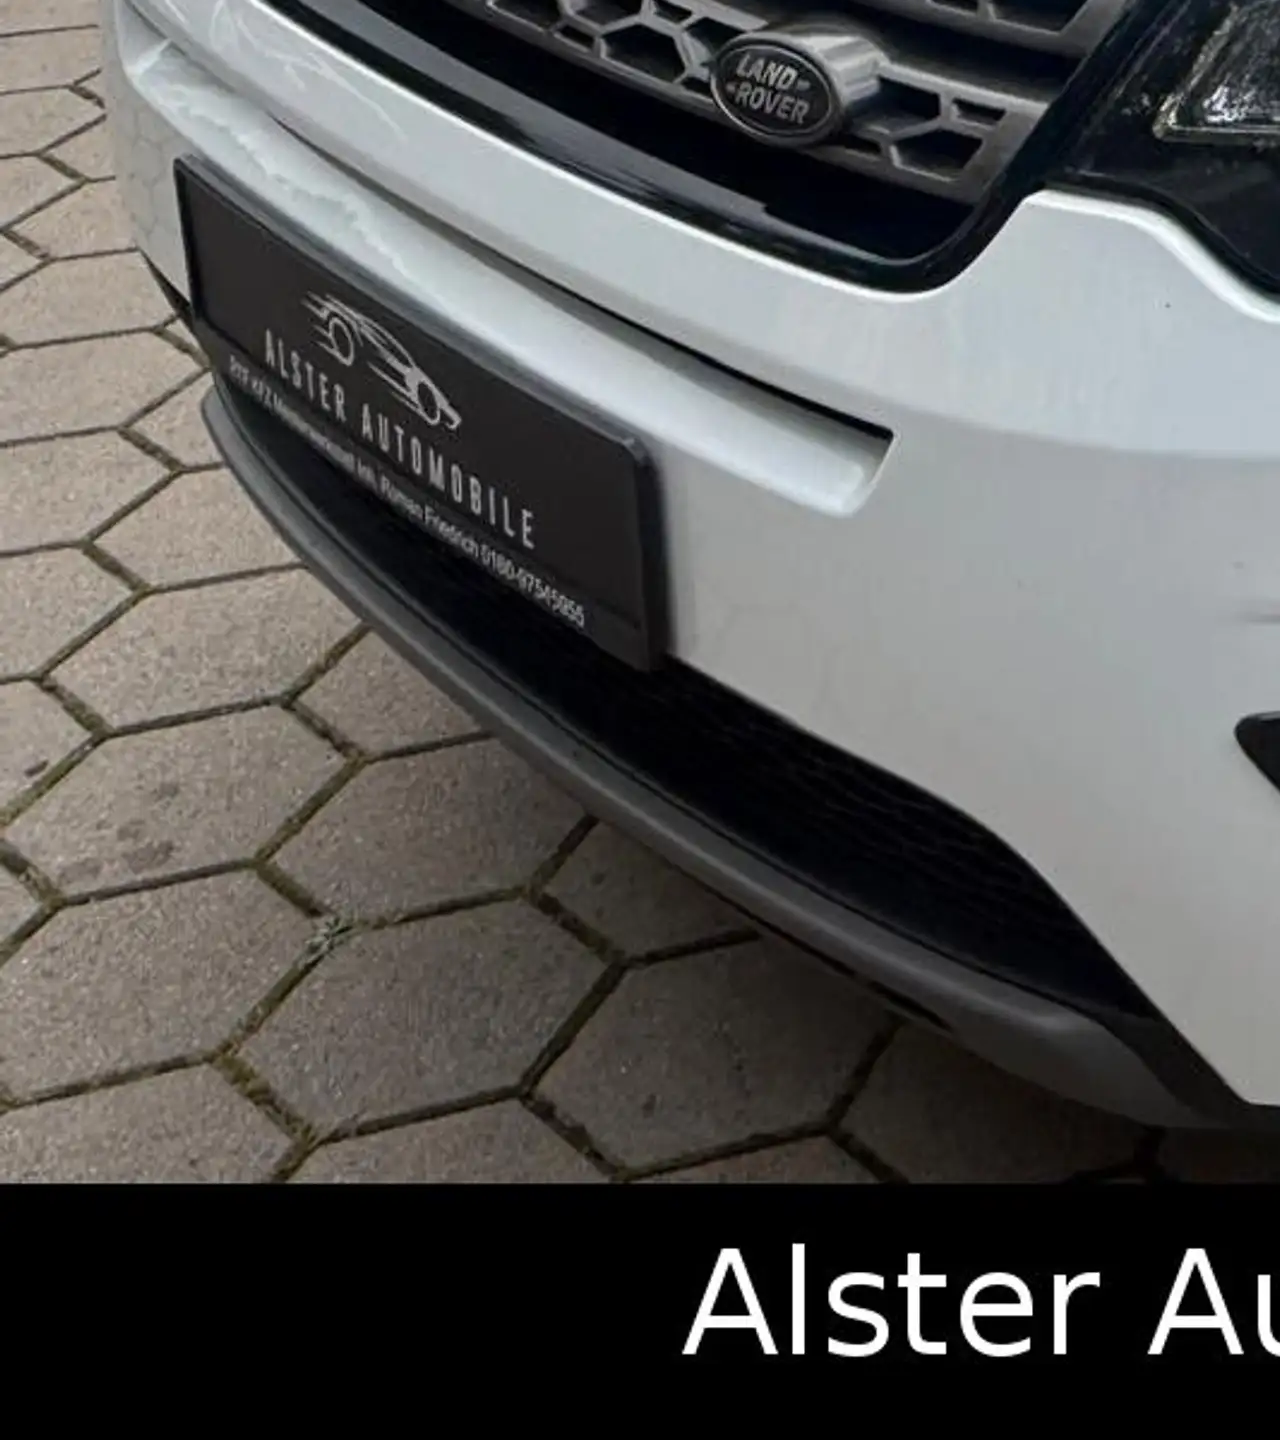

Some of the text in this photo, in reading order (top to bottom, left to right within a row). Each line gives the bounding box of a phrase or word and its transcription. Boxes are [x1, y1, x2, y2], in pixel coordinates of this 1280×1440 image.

[735, 52, 799, 91] LAND
[734, 81, 810, 125] ROVER
[265, 328, 347, 423] ALSTER
[361, 403, 535, 550] AUTOMOBILE
